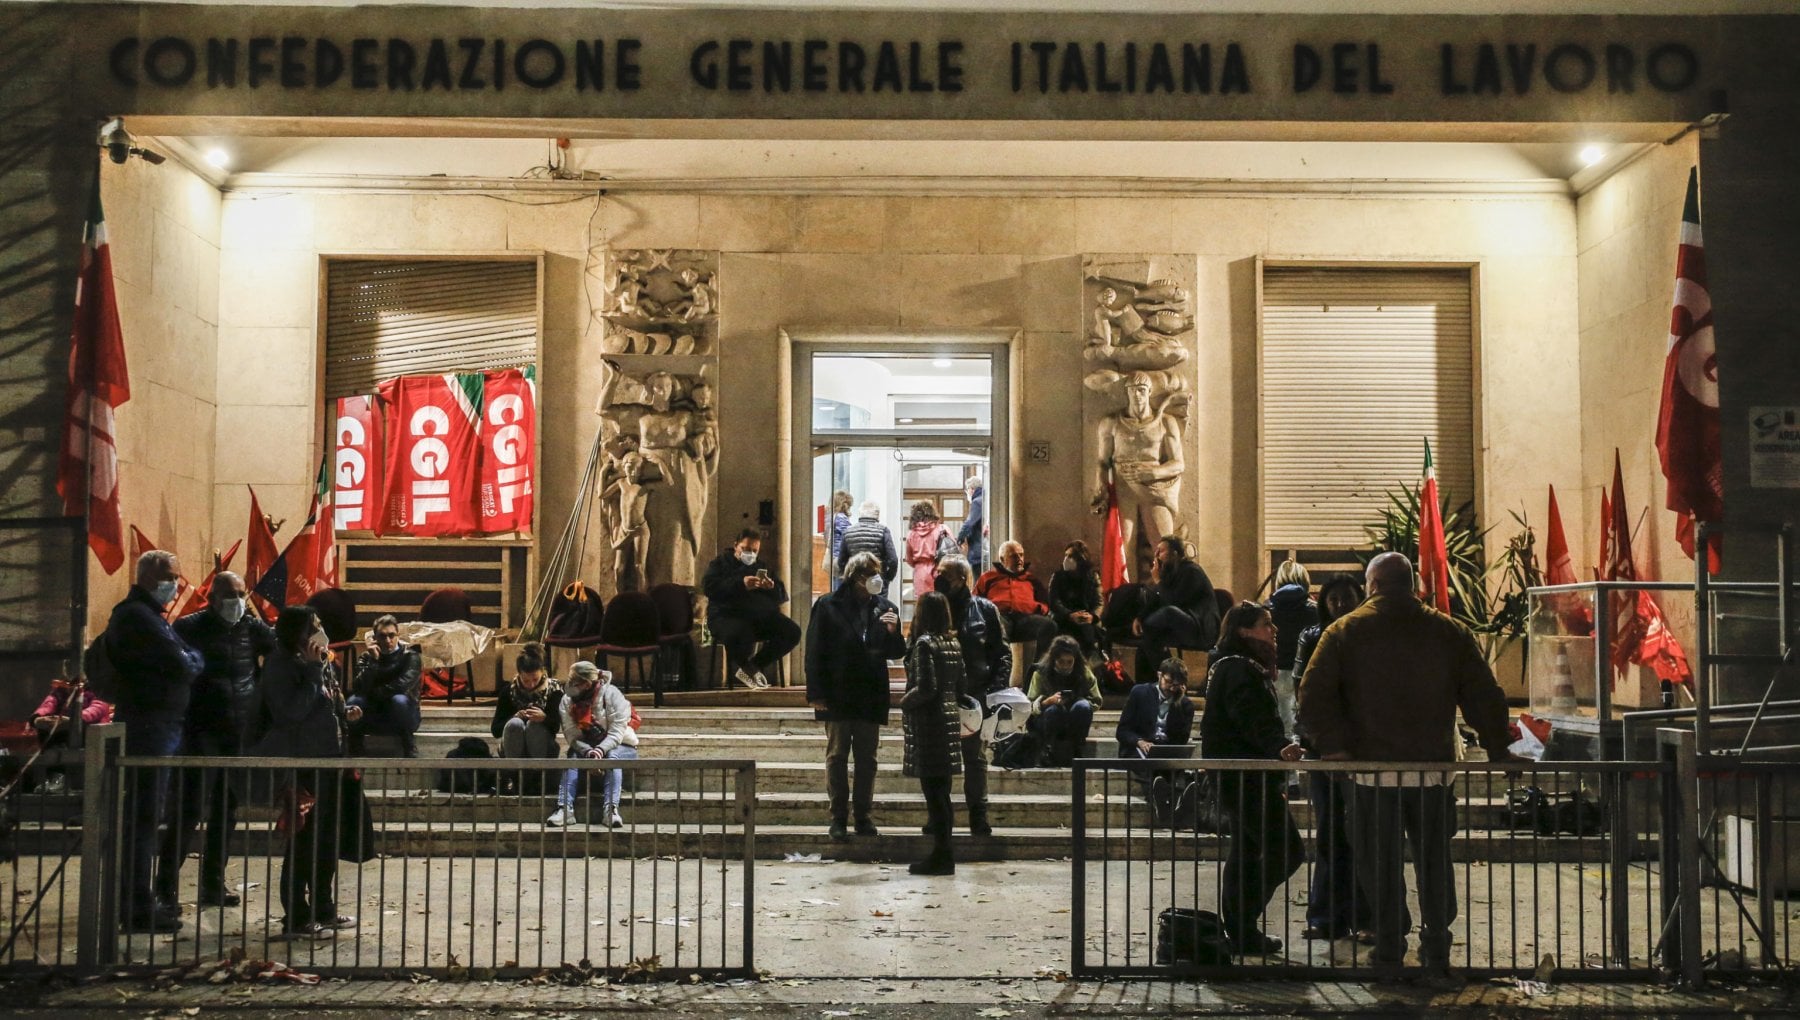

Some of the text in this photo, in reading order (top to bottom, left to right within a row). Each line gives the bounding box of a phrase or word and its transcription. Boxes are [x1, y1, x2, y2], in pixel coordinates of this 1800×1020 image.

[110, 37, 1699, 94] CONFEDERAZIONE GENERALE ITALIANA DEL LAVORO
[335, 416, 366, 530] CGIL
[410, 405, 450, 526] CGIL
[488, 394, 532, 514] CGIL
[1033, 446, 1047, 459] 25
